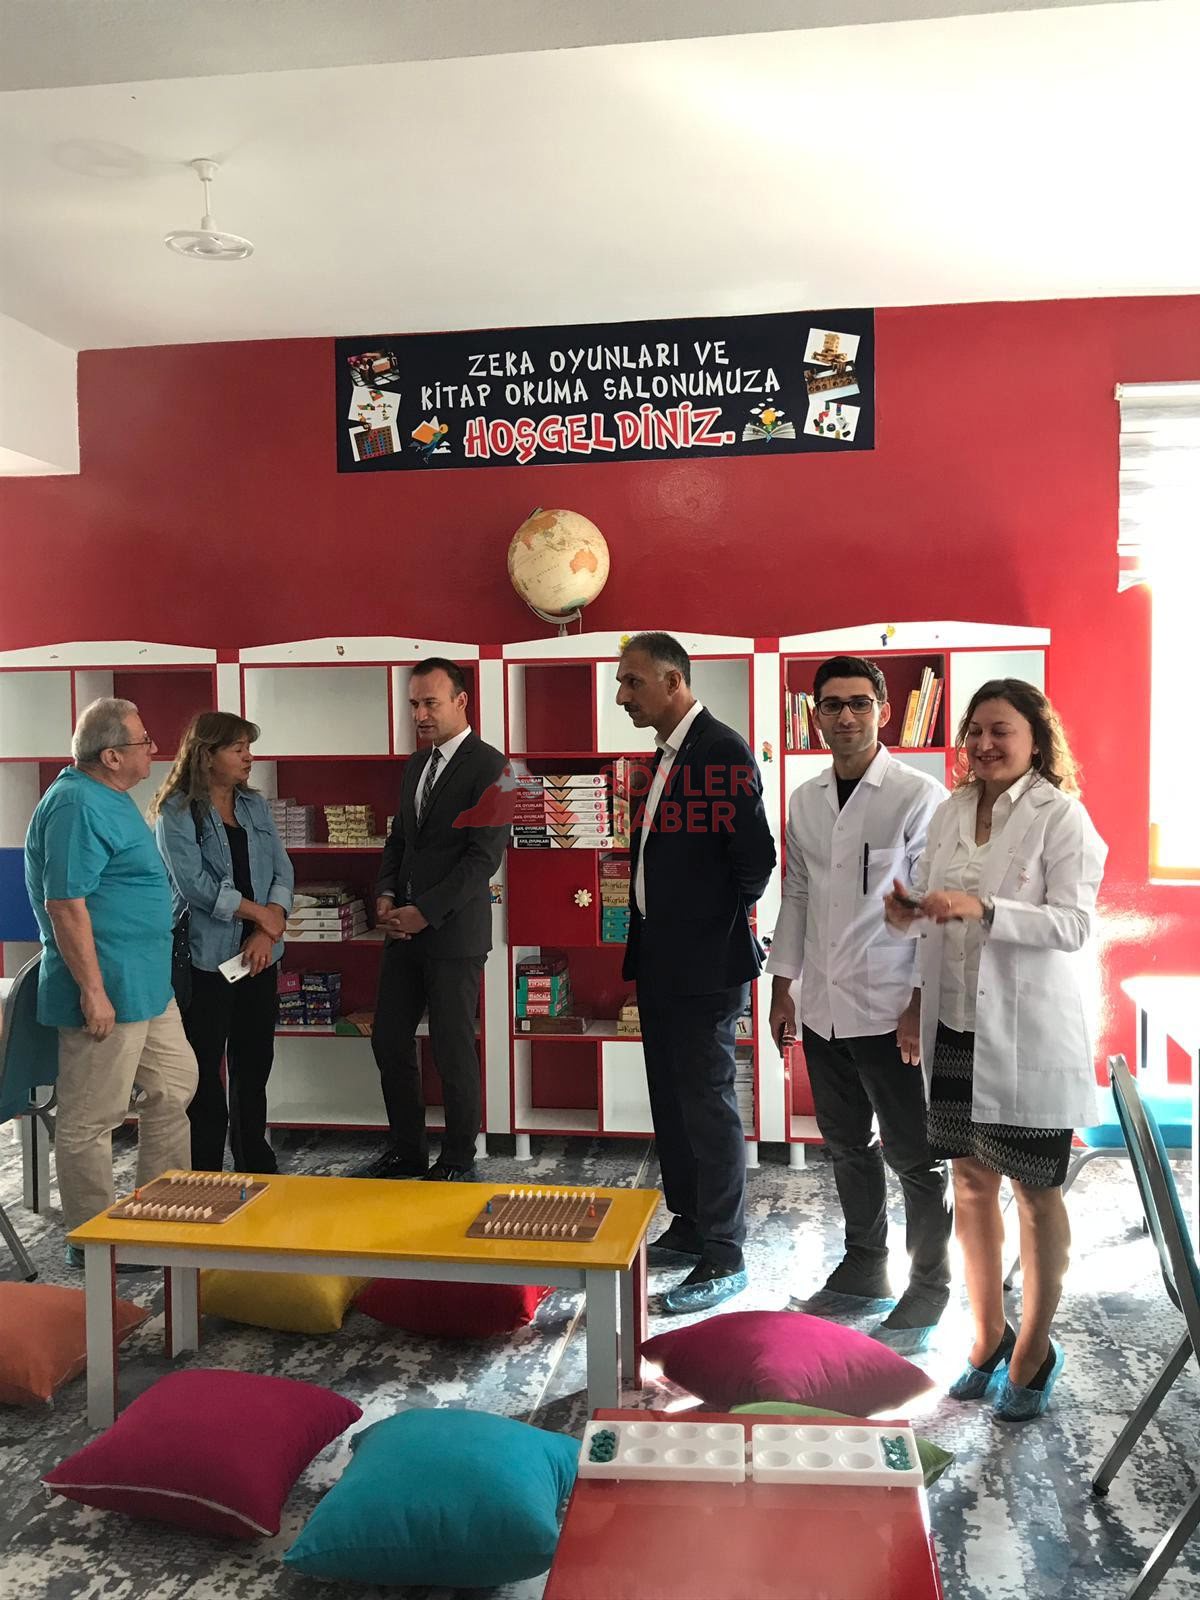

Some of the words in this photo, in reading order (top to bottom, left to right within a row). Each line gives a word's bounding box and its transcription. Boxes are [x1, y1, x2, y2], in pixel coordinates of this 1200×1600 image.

[468, 350, 535, 377] ZEKA
[550, 343, 679, 375] OYUNLARI
[693, 340, 729, 366] VE
[421, 381, 491, 411] KİTAP
[505, 377, 589, 406] OKUMA
[603, 367, 781, 401] SALONUMUZA
[463, 400, 736, 464] HOŞGELDİNİZ.
